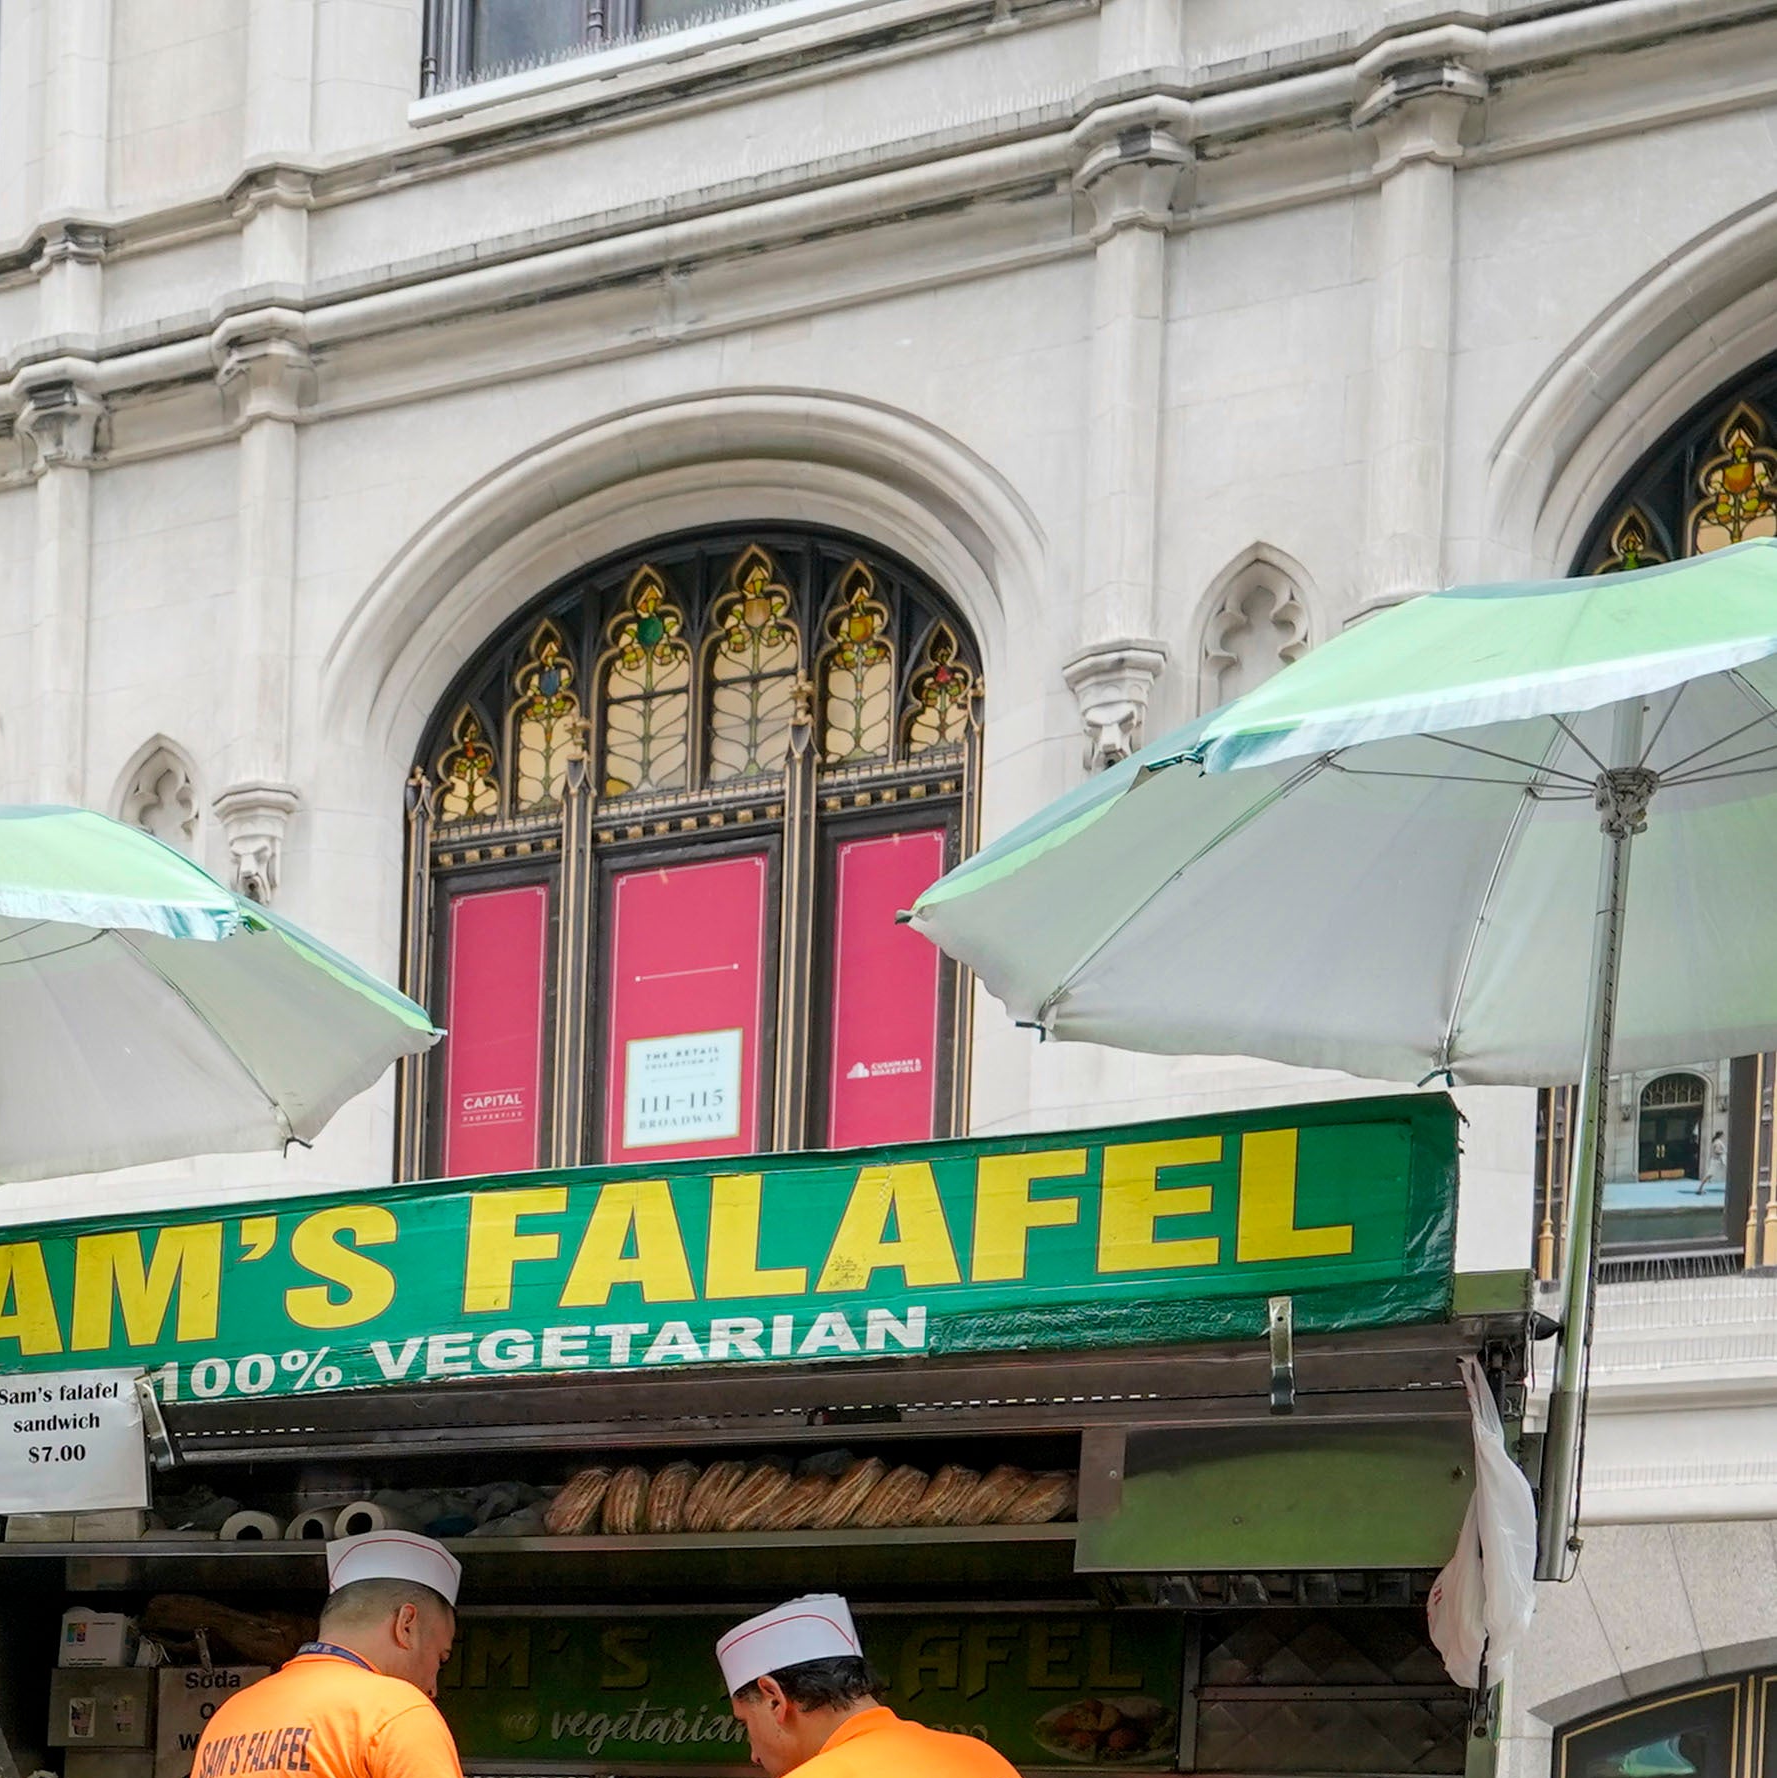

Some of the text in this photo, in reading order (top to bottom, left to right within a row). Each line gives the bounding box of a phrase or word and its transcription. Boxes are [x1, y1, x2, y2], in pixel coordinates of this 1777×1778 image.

[463, 1092, 522, 1110] CAPITAL
[462, 1111, 523, 1123] PROPERTIES
[638, 1112, 724, 1130] BROADWAY
[462, 1128, 1353, 1315] FALAFEL
[149, 1306, 927, 1401] 100% VEGETARIAN
[59, 1382, 119, 1402] falafel
[13, 1412, 101, 1434] sandwich
[28, 1444, 87, 1465] $7.00
[185, 1671, 241, 1689] Soda
[242, 1727, 313, 1774] FALAFEL
